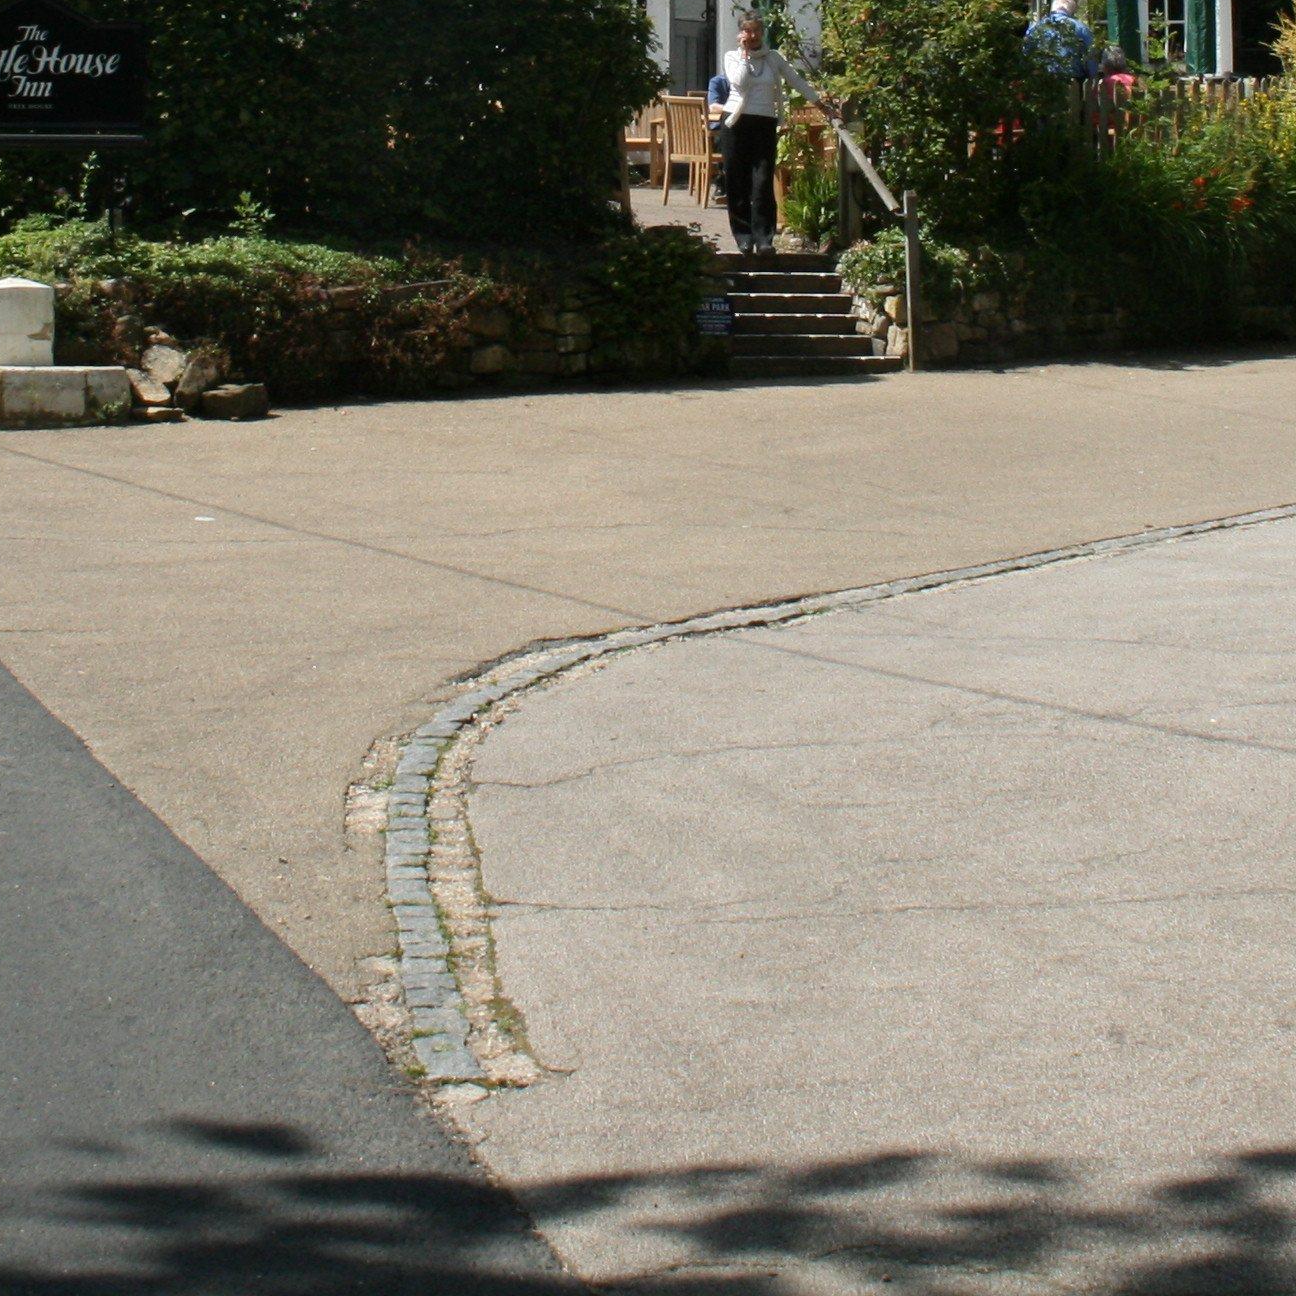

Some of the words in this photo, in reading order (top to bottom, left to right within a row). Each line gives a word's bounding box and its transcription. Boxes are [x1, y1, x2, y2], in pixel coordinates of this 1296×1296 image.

[16, 24, 49, 42] The
[27, 44, 121, 78] House
[8, 75, 54, 98] Inn
